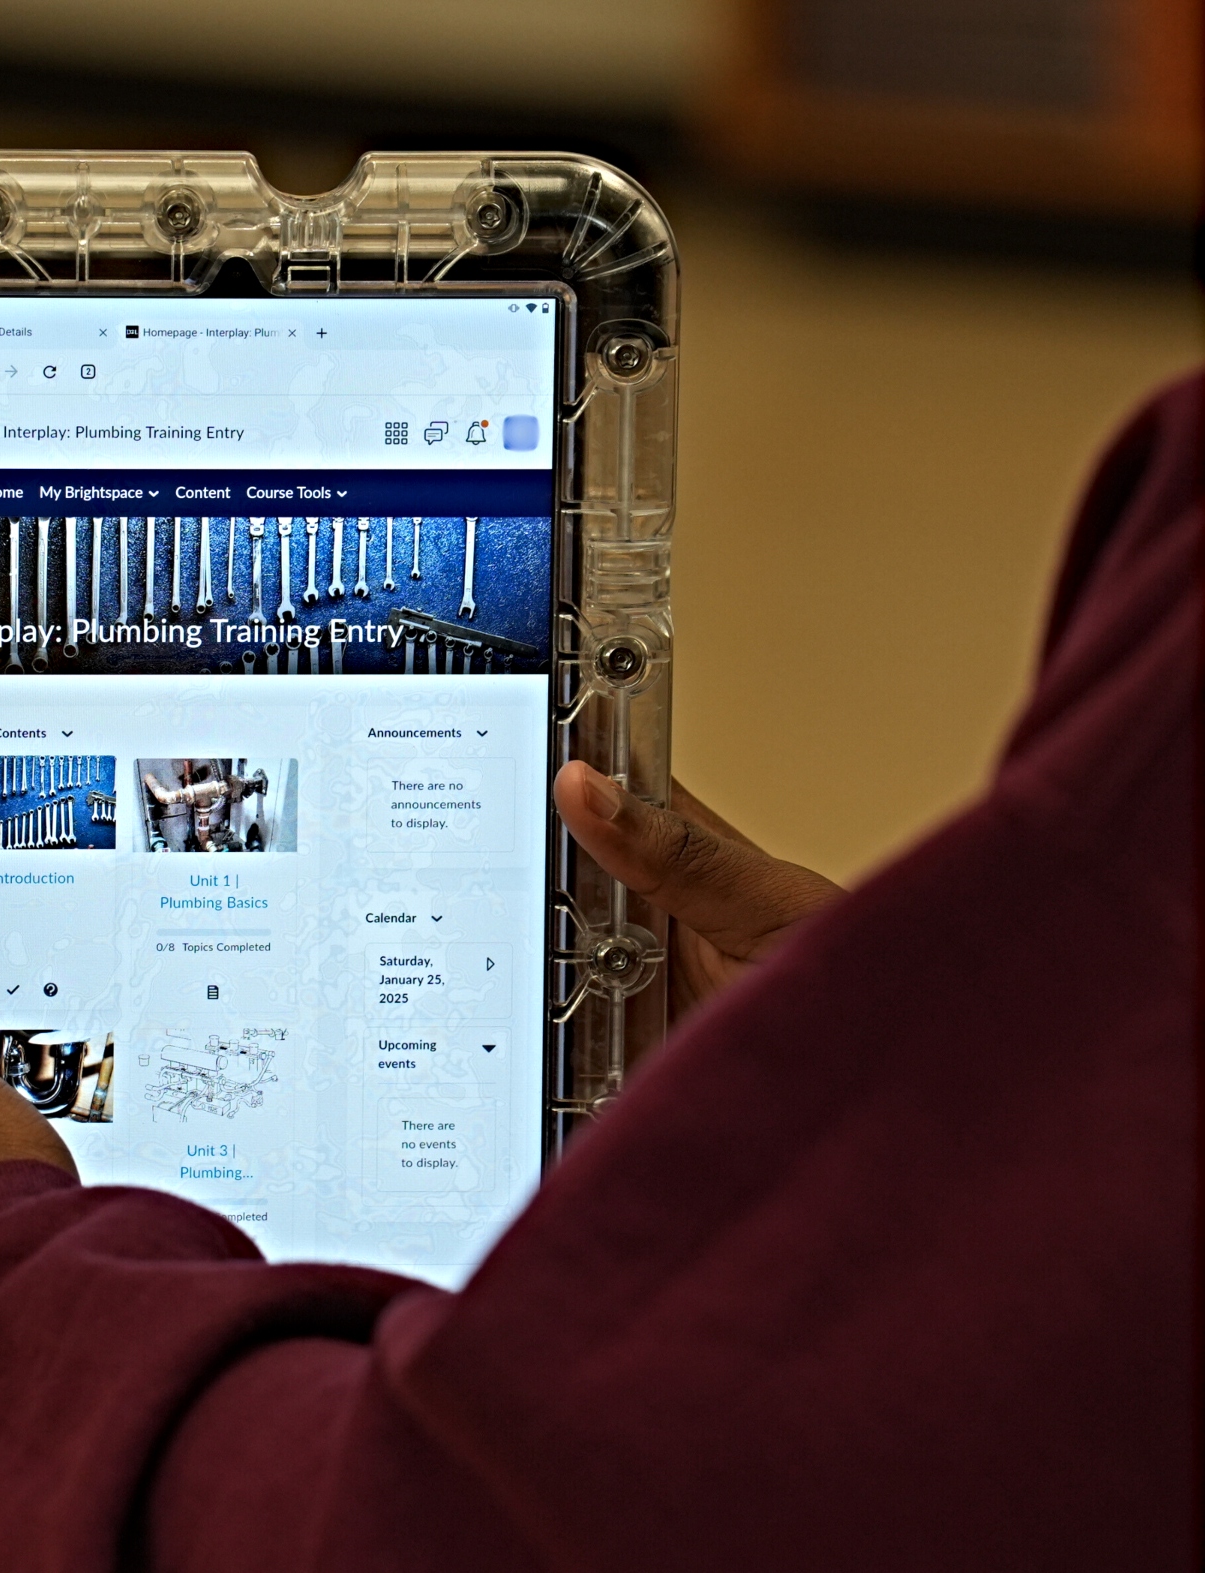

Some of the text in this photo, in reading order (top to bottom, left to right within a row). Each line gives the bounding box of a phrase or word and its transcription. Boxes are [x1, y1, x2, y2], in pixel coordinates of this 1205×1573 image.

[143, 327, 197, 340] Homepage
[206, 327, 251, 340] Interplay:
[3, 425, 245, 442] Interplay: Plumbing Training Entry
[39, 485, 144, 502] My Brightspace
[175, 485, 232, 499] Content
[246, 485, 332, 499] Course Tools
[72, 617, 202, 648] Plumbing
[209, 618, 321, 648] Training
[330, 619, 404, 648] Entry
[367, 727, 462, 738] Announcements
[391, 780, 464, 791] There are no
[390, 800, 482, 810] announcements
[390, 818, 448, 830] to display.
[190, 874, 219, 887] Unit
[223, 874, 231, 887] 1
[160, 896, 269, 912] Plumbing Basics
[365, 912, 417, 924] Calendar
[156, 942, 271, 954] 0/8 Topics Completed
[379, 955, 433, 968] Saturday,
[378, 974, 445, 987] January 25,
[379, 993, 409, 1004] 2025
[378, 1039, 437, 1053] Upcoming
[378, 1059, 416, 1069] events
[401, 1120, 456, 1131] There are
[187, 1144, 216, 1157] Unit
[219, 1144, 228, 1157] 3
[401, 1139, 457, 1150] no events
[401, 1157, 458, 1170] to display.
[180, 1166, 254, 1181] Plumbing...
[217, 1211, 268, 1223] ompleted
